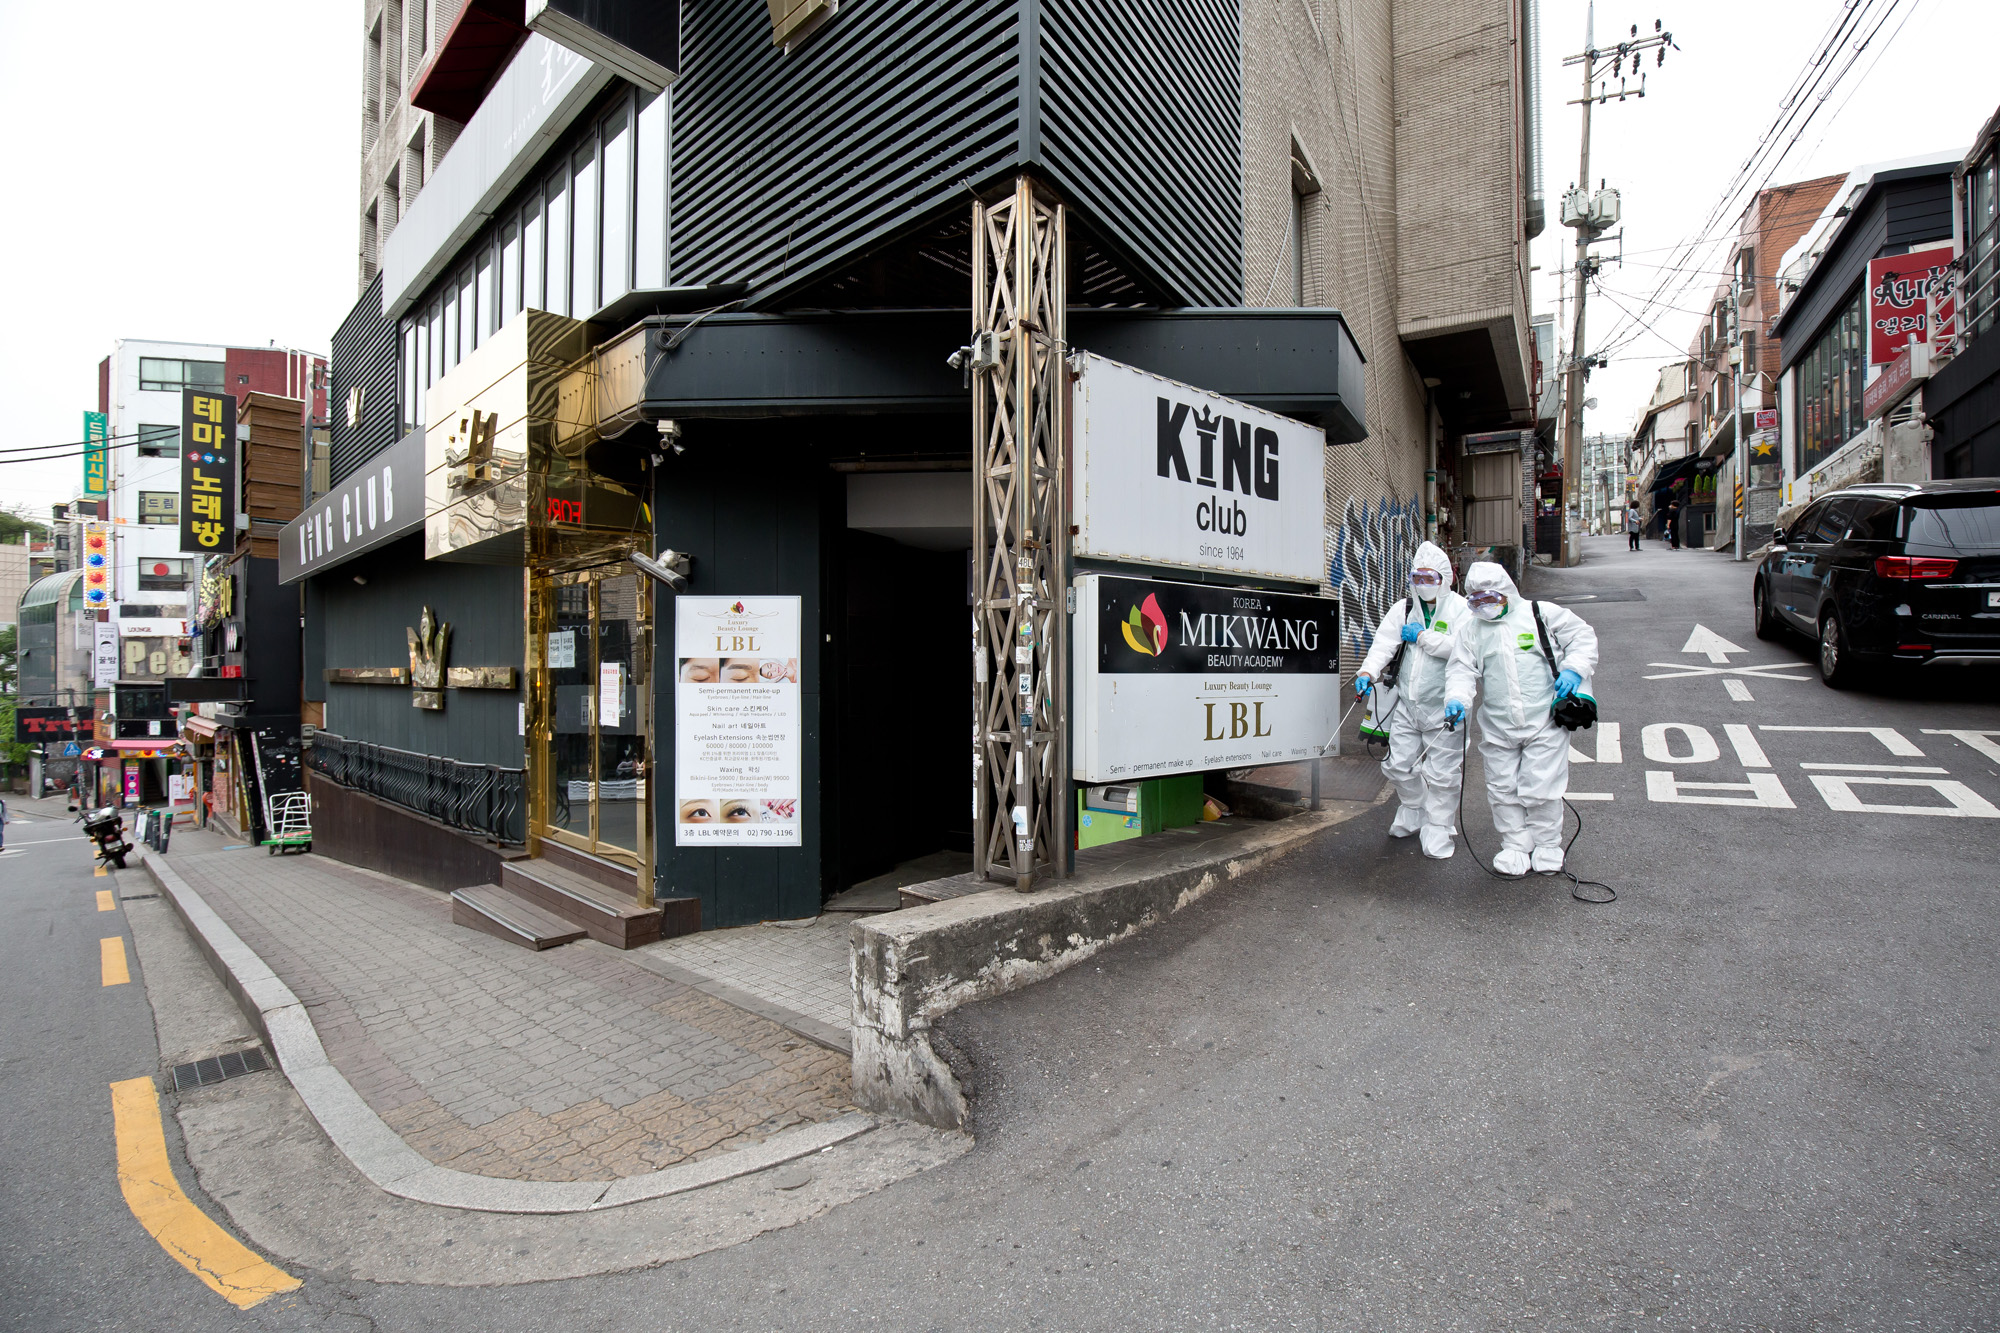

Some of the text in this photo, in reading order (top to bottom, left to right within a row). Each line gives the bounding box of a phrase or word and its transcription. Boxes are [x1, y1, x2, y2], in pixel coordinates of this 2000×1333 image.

[192, 395, 226, 450] 테마
[1157, 396, 1279, 501] KING
[147, 498, 174, 510] 드림
[191, 467, 225, 547] 노래방
[299, 465, 394, 566] KING CLUB
[1196, 495, 1247, 537] club
[1199, 542, 1244, 561] since 1964
[1232, 597, 1262, 610] KOREA
[717, 625, 759, 633] Beauty Lounge
[727, 619, 749, 627] Luxury
[1179, 611, 1319, 651] MIKWANG
[715, 636, 761, 652] LBL
[1207, 654, 1284, 667] BEAUTY ACADEMY
[1328, 659, 1337, 669] 3F
[1204, 681, 1272, 692] Luxury Beauty Lounge
[1203, 701, 1272, 741] LBL
[693, 734, 718, 742] Eyelash
[1261, 750, 1282, 758] Nail care
[1291, 747, 1307, 755] Waxing
[1109, 758, 1193, 774] Semi permanent make up
[1204, 753, 1252, 766] Eyelash extensions
[719, 766, 743, 774] Waxing
[684, 829, 695, 837] 3층
[712, 829, 740, 837] 예약문의
[747, 829, 758, 838] 02)
[760, 829, 773, 837] 790
